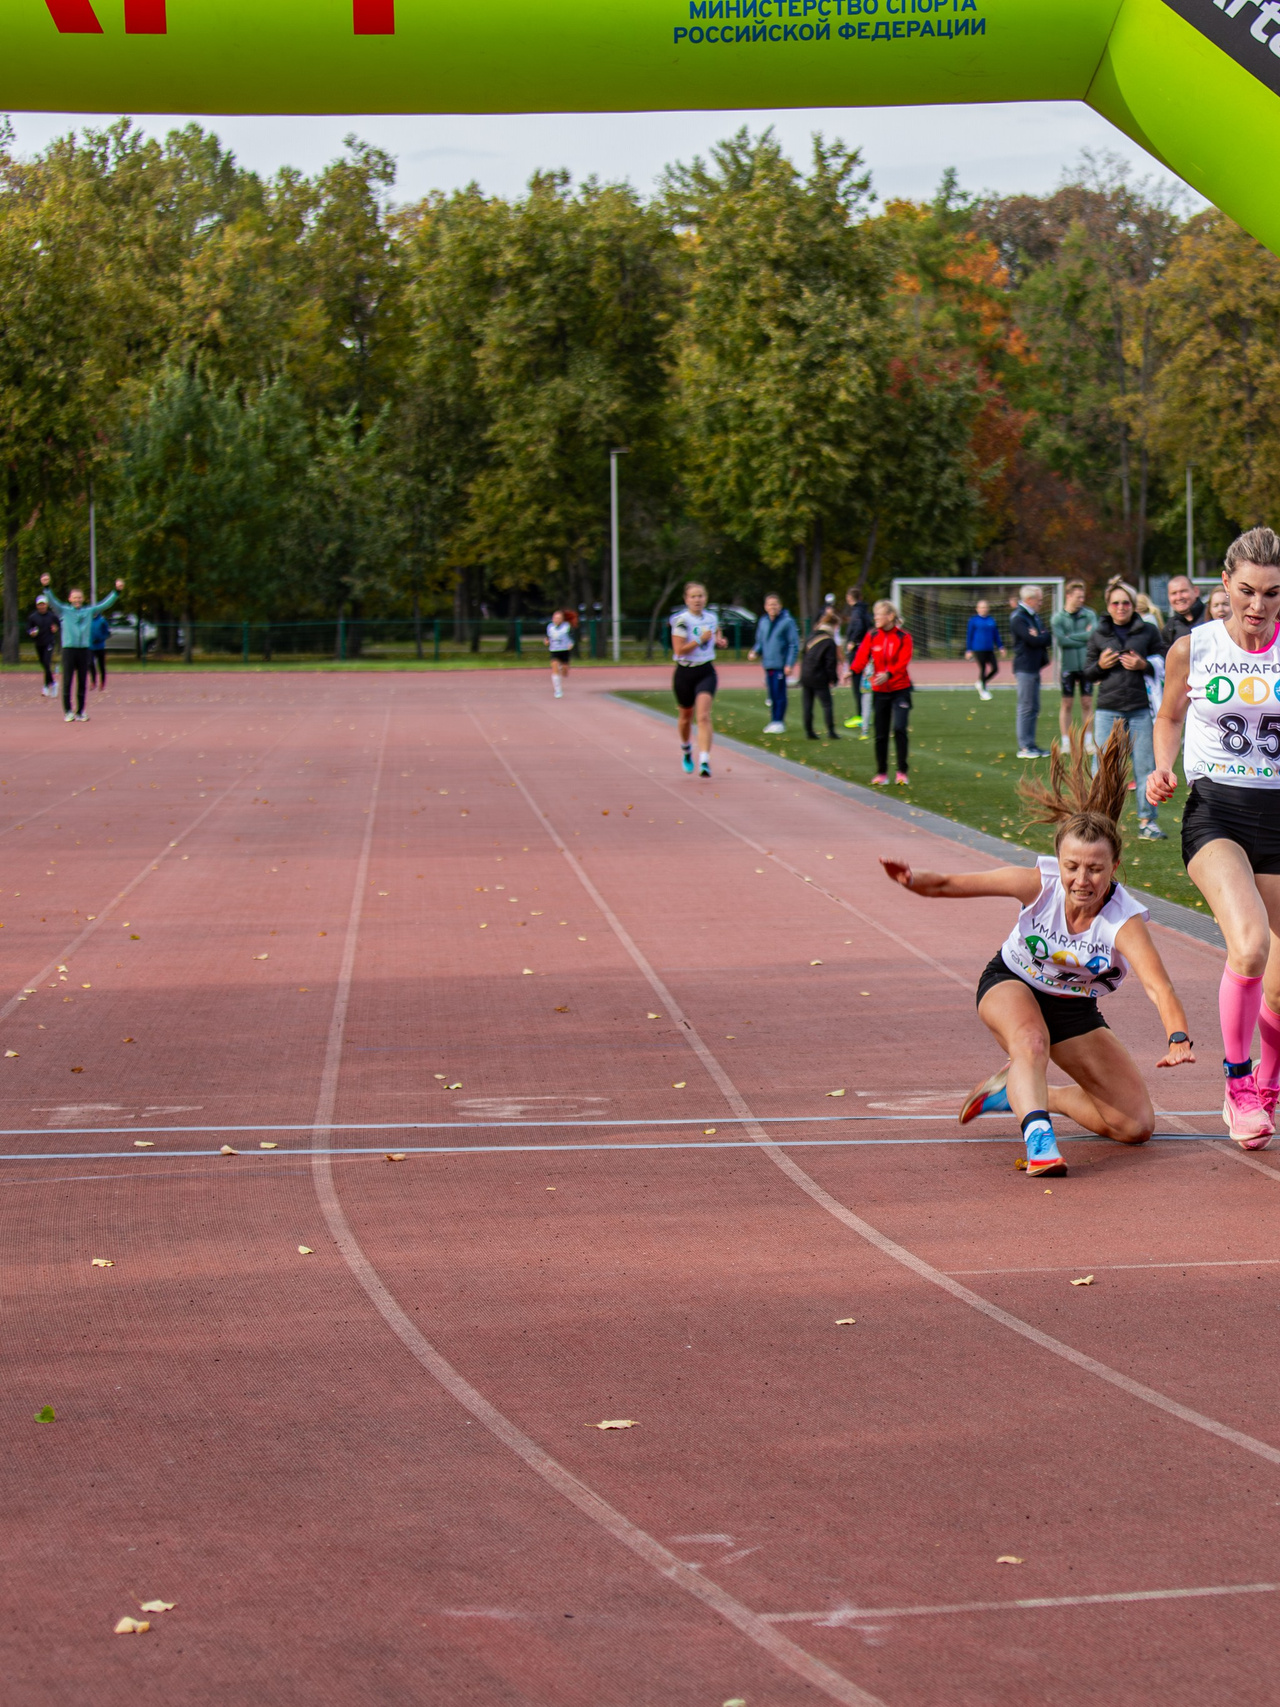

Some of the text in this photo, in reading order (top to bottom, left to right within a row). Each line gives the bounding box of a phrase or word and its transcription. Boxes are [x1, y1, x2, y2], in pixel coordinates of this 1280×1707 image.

[688, 0, 977, 19] МИНИСТЕРСТВО СПОРТА
[673, 18, 987, 44] РОССИЙСКОЙ ФЕДЕРАЦИИ
[1031, 918, 1112, 956] VMARAFONE
